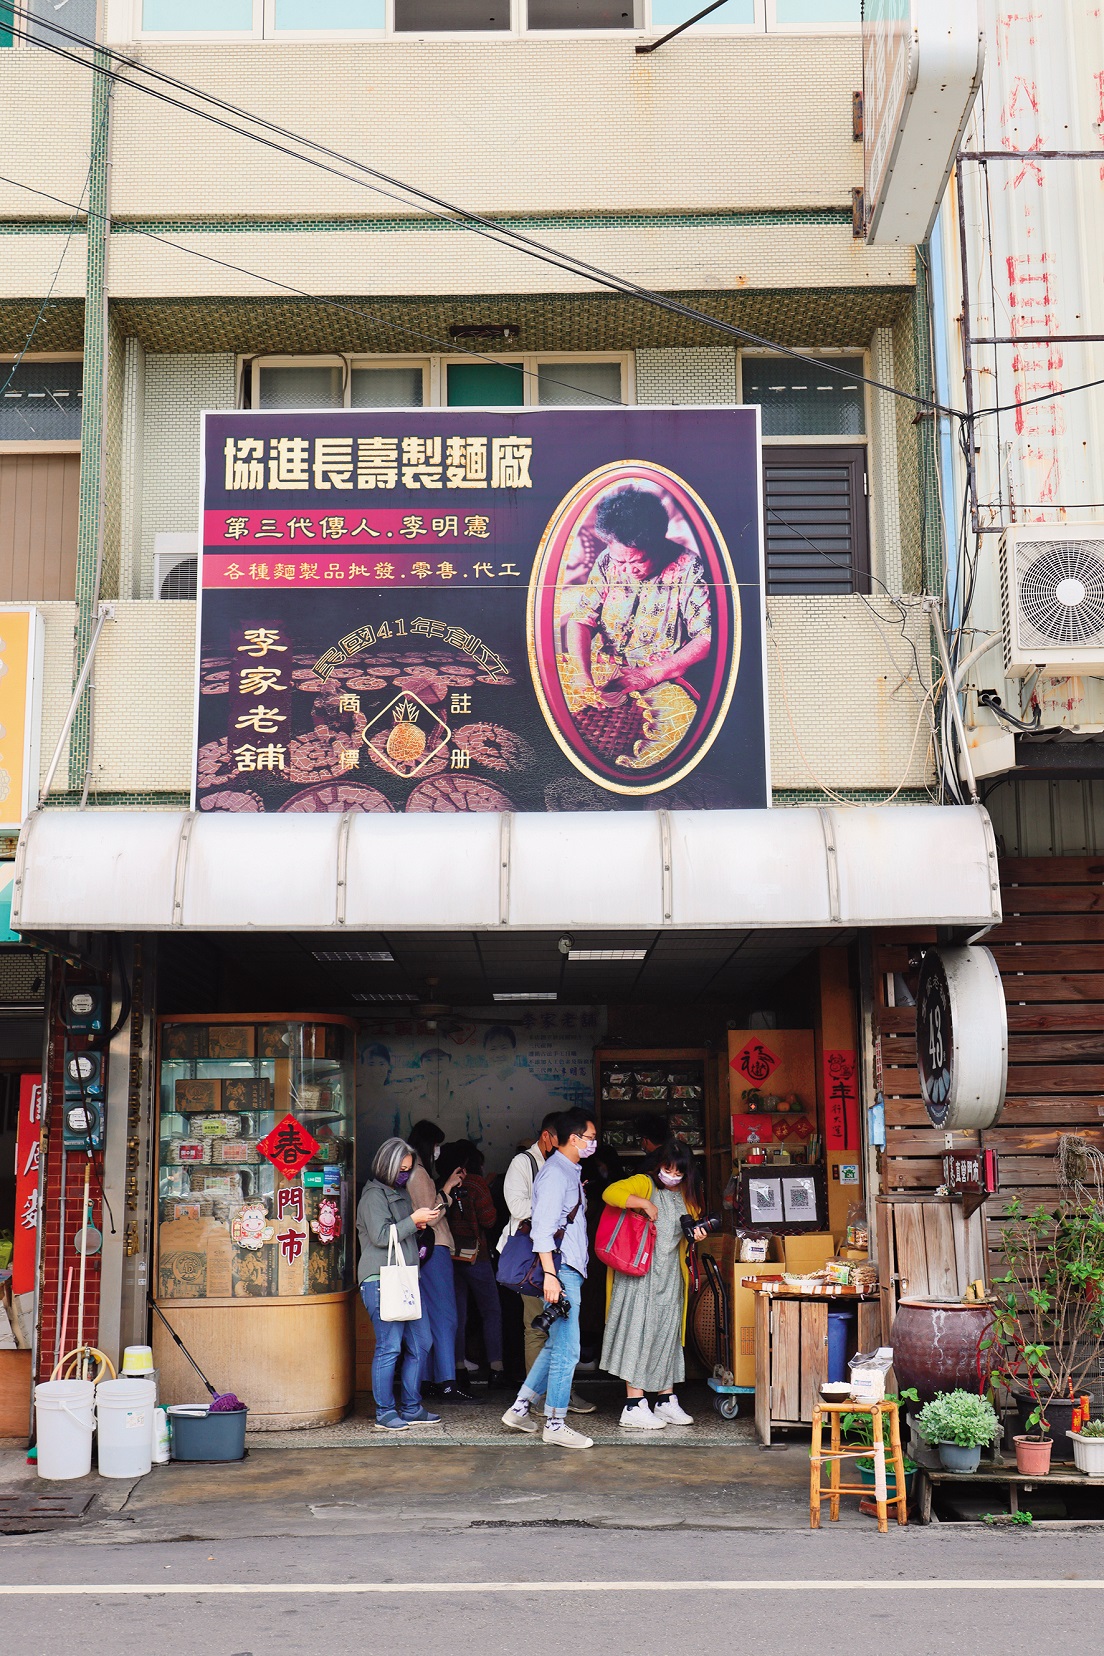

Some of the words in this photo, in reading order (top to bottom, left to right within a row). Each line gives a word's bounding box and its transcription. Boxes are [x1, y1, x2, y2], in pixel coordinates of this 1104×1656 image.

[224, 437, 533, 490] 協進長壽製麵廠
[311, 616, 509, 684] 民國41年創立
[233, 627, 289, 772] 李家老舖
[928, 1005, 943, 1070] 43
[270, 1124, 311, 1164] 春
[955, 1158, 979, 1183] 直營門市
[277, 1187, 306, 1265] 門市
